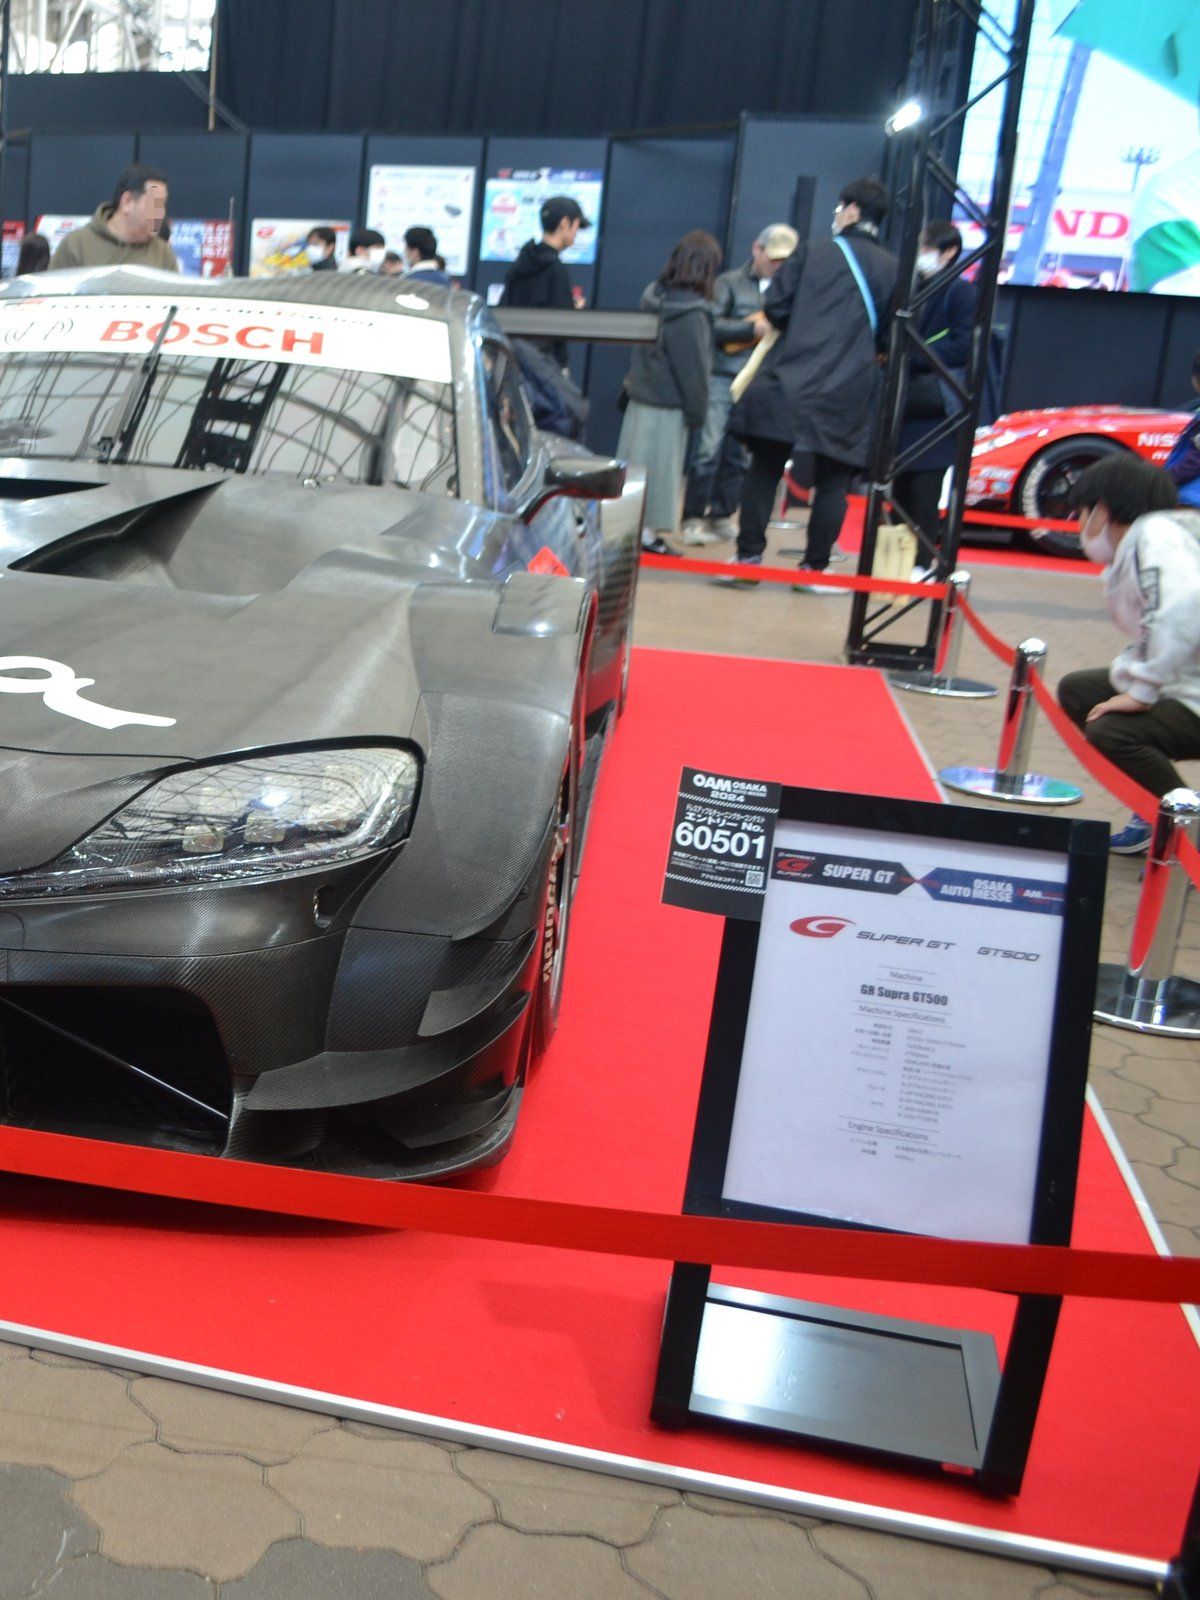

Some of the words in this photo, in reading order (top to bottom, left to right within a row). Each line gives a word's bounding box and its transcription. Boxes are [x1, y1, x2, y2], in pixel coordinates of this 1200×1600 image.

[100, 319, 324, 355] BOSCH
[1137, 433, 1179, 448] NIS
[693, 774, 732, 793] OAM
[732, 781, 767, 793] OSAKA
[710, 790, 745, 803] 2024
[684, 811, 738, 828] エントリー
[741, 822, 765, 833] No.
[675, 821, 766, 860] 60501
[822, 863, 869, 882] SUPER
[874, 870, 895, 884] GT
[940, 884, 971, 898] AUTO
[972, 888, 1013, 903] MESSE
[973, 878, 1014, 893] OSAKA
[856, 931, 924, 947] SUPER
[926, 940, 956, 951] GT
[976, 946, 1041, 962] GT500
[889, 971, 923, 982] Machine
[860, 983, 875, 996] GR
[877, 986, 910, 1001] Supra
[912, 991, 948, 1006] GT500
[858, 1005, 892, 1017] Machine
[893, 1009, 946, 1024] Specifications
[848, 1121, 875, 1132] Engine
[875, 1125, 928, 1141] Specifications
